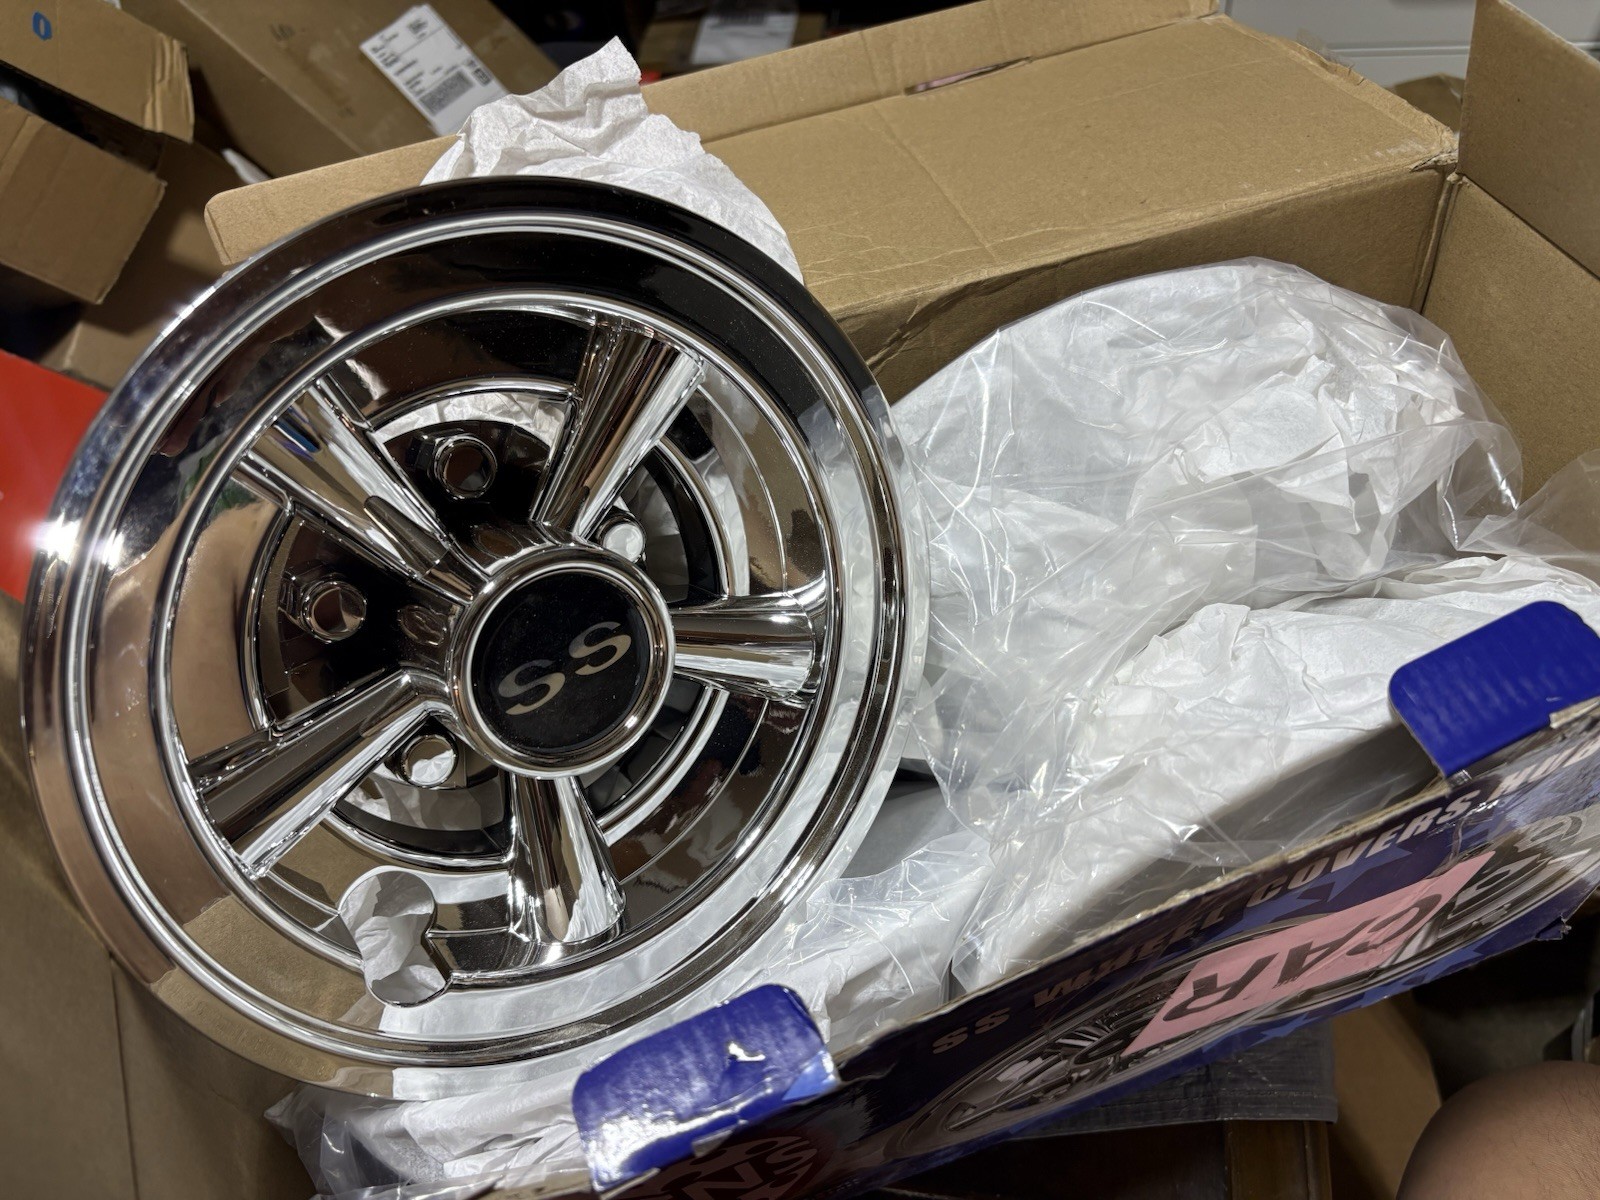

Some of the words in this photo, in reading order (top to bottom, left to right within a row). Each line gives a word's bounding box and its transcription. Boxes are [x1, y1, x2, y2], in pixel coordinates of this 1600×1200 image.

[499, 621, 632, 716] SS
[932, 1007, 1010, 1054] SS
[1033, 901, 1226, 1009] WHEEL
[1246, 789, 1481, 908] COVERS
[1163, 894, 1442, 1021] CAR
